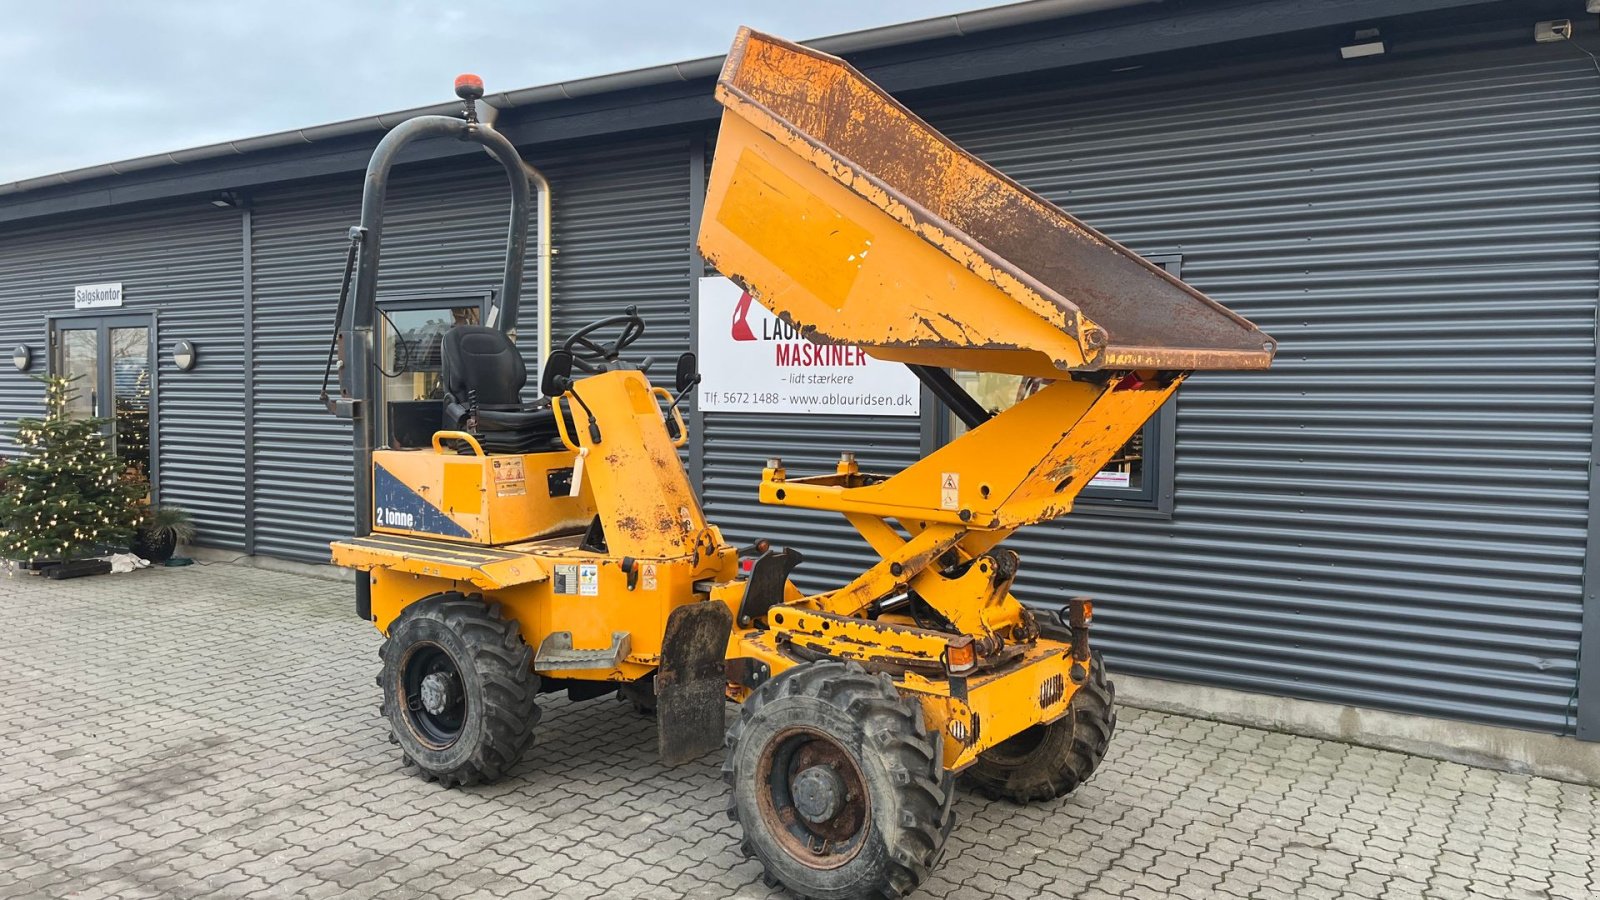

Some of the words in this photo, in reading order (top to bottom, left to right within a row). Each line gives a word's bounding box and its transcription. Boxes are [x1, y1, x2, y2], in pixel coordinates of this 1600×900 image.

[76, 288, 120, 305] Salgskontor
[776, 343, 867, 367] MASKINER
[789, 373, 805, 384] lidt
[807, 373, 854, 384] stærkere
[704, 392, 720, 405] Tlf.
[723, 392, 749, 404] 5672
[752, 393, 779, 404] 1488
[789, 393, 912, 406] www.ablauridsen.dk
[376, 506, 384, 524] 2
[385, 507, 414, 527] tonne
